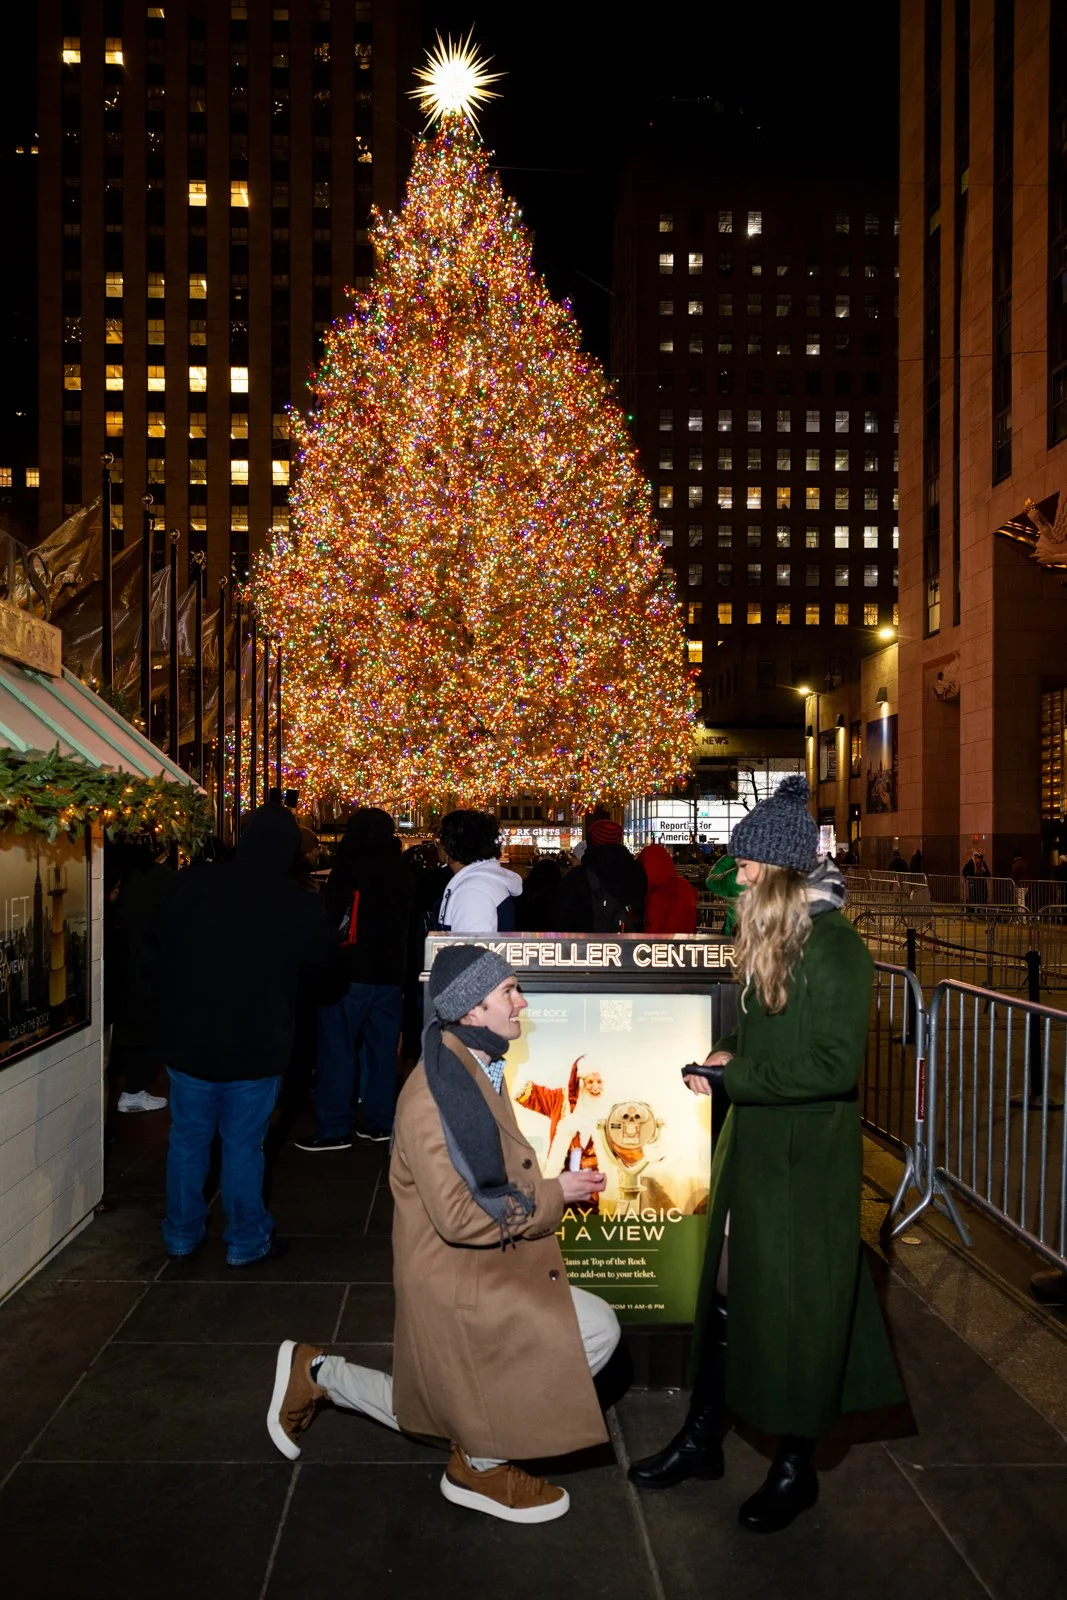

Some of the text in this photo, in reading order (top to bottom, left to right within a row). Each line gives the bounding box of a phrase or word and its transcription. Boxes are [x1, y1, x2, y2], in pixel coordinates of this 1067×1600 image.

[702, 736, 729, 745] NEWS
[660, 821, 694, 832] Report
[504, 828, 530, 836] YRK
[660, 832, 690, 841] Americ
[3, 896, 30, 942] IFT
[432, 942, 738, 967] KEFELLER CENTER
[544, 1008, 568, 1018] ROCK
[561, 1207, 683, 1223] AY MAGIC
[575, 1226, 592, 1241] A
[601, 1226, 665, 1241] VIEW
[590, 1258, 605, 1267] Top
[606, 1257, 614, 1265] of
[614, 1257, 626, 1265] the
[628, 1257, 646, 1265] Rock
[580, 1270, 606, 1278] add-on
[616, 1272, 633, 1280] your
[634, 1270, 656, 1278] ticket.
